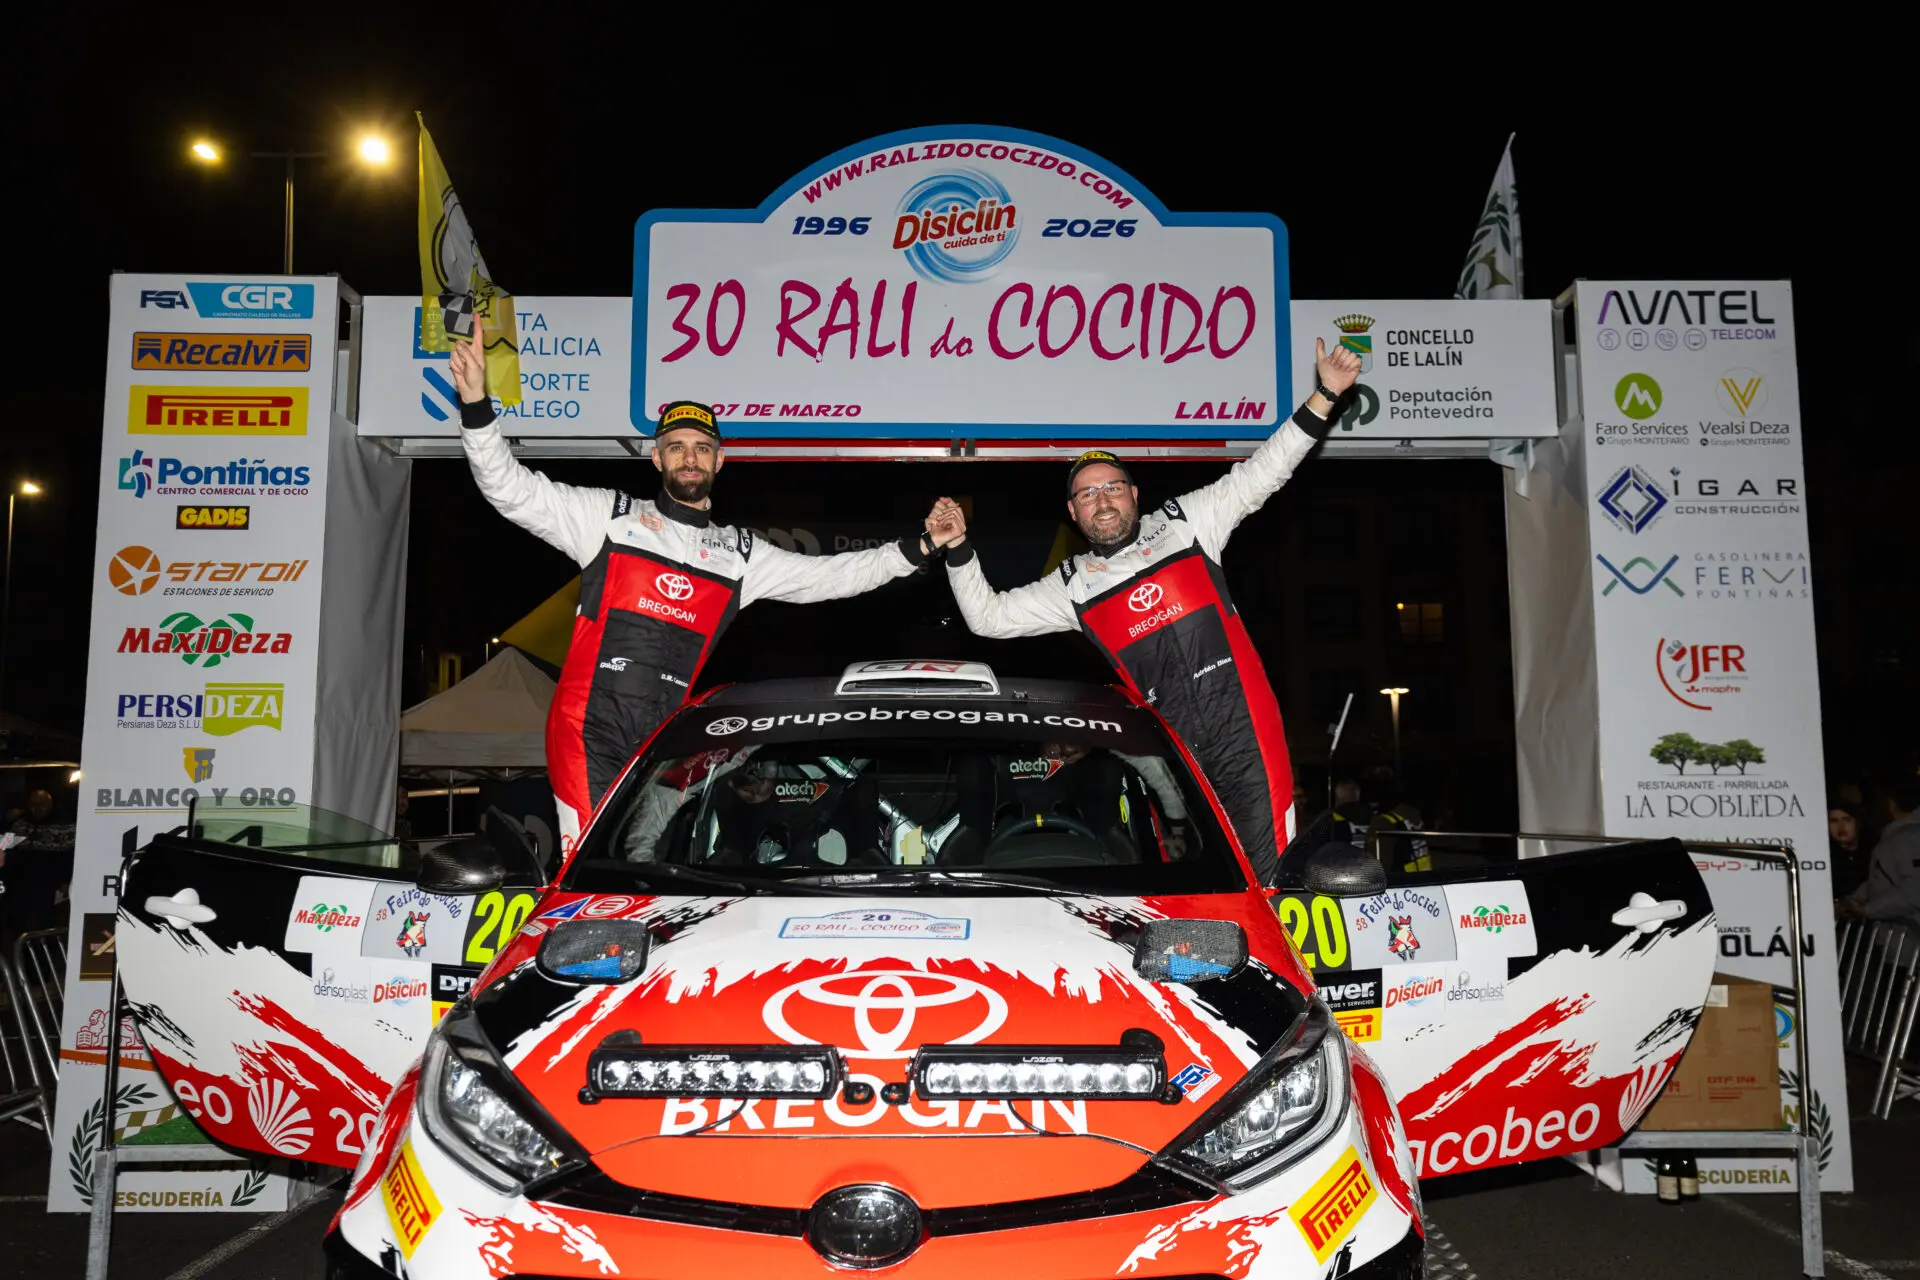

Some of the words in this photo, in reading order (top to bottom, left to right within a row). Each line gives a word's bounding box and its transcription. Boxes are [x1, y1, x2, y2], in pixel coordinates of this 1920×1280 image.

[802, 143, 1136, 210] WWW.RALIDOCOCIDO.COM
[792, 216, 872, 236] 1996
[892, 200, 1017, 250] Disiclin
[1042, 218, 1140, 238] 2026
[943, 236, 978, 250] cuida
[979, 234, 995, 244] de
[996, 231, 1006, 242] ti
[221, 285, 293, 310] CGR
[1597, 290, 1775, 325] AVATEL
[660, 279, 746, 363] 30
[775, 278, 919, 363] RALI
[930, 317, 974, 360] do
[987, 282, 1257, 364] COCIDO
[1386, 329, 1474, 345] CONCELLO
[1710, 329, 1776, 340] TELECOM
[165, 338, 280, 366] Recalvi
[519, 337, 602, 356] ALICIA
[1388, 352, 1410, 366] DE
[1415, 346, 1463, 366] LALÍN
[519, 374, 590, 392] PORTE
[1389, 386, 1492, 407] Deputación
[146, 395, 293, 426] PIRELLI
[744, 404, 775, 417] DE
[778, 404, 862, 417] MARZO
[1174, 396, 1267, 420] LALÍN
[1390, 405, 1493, 419] Pontevedra
[1596, 423, 1627, 435] Faro
[1631, 422, 1689, 435] Services
[1699, 421, 1746, 435] Vealsi
[1750, 421, 1790, 434] Deza
[1607, 436, 1632, 446] Grupo
[1633, 436, 1690, 445] MONTEFARO
[1710, 438, 1736, 447] Grupo
[1736, 438, 1790, 446] MONTEFARO
[158, 457, 310, 486] Pontiñas
[157, 487, 196, 496] CENTRO
[199, 487, 256, 496] COMERCIAL
[258, 487, 265, 496] Y
[267, 487, 280, 496] DE
[283, 487, 309, 496] OCIO
[180, 508, 248, 527] GADIS
[1675, 501, 1800, 515] CONSTRUCCIÓN
[1694, 552, 1806, 562] GASOLINERA
[1695, 566, 1807, 585] FERVI
[163, 588, 219, 597] ESTACIONES
[219, 588, 232, 596] DE
[232, 588, 274, 597] SERVICIO
[1696, 588, 1808, 598] PONTIÑAS
[638, 597, 697, 624] BREOGAN
[1128, 602, 1183, 638] BREOGAN
[117, 627, 292, 654] MaxiDeza
[1676, 644, 1746, 683] JFR
[1701, 685, 1741, 694] mapfre
[117, 720, 155, 729] Persianas
[156, 720, 177, 729] Deza
[178, 720, 203, 729] S.L.U.
[751, 706, 1123, 734] grupobreogan.com
[1009, 757, 1048, 773] atech
[775, 781, 815, 796] atech
[1637, 781, 1714, 790] RESTAURANTE
[1724, 781, 1789, 790] PARRILLADA
[97, 787, 200, 808] BLANCO
[211, 788, 229, 806] Y
[239, 787, 296, 807] ORO
[1625, 795, 1656, 818] LA
[1667, 794, 1806, 818] ROBLEDA
[386, 887, 420, 915] Feira
[418, 893, 431, 908] do
[1359, 892, 1392, 923] Feira
[1392, 892, 1404, 911] do
[1403, 888, 1440, 918] Cocido
[294, 909, 360, 928] MaxiDeza
[465, 891, 535, 964] 20
[862, 914, 891, 922] 20
[1355, 917, 1368, 931] 58
[1460, 911, 1527, 929] MaxiDeza
[860, 924, 920, 932] COCIDO
[1278, 895, 1347, 969] 20
[314, 983, 368, 1001] densoplast
[1447, 983, 1505, 1002] densoplast
[659, 1074, 1088, 1136] BREOGAN
[1407, 1103, 1600, 1177] acobeo
[1697, 1165, 1791, 1185] SCUDERÍA
[115, 1186, 224, 1207] ESCUDERÍA
[386, 1149, 432, 1246] PIRELLI
[1299, 1159, 1373, 1252] PIRELLI
